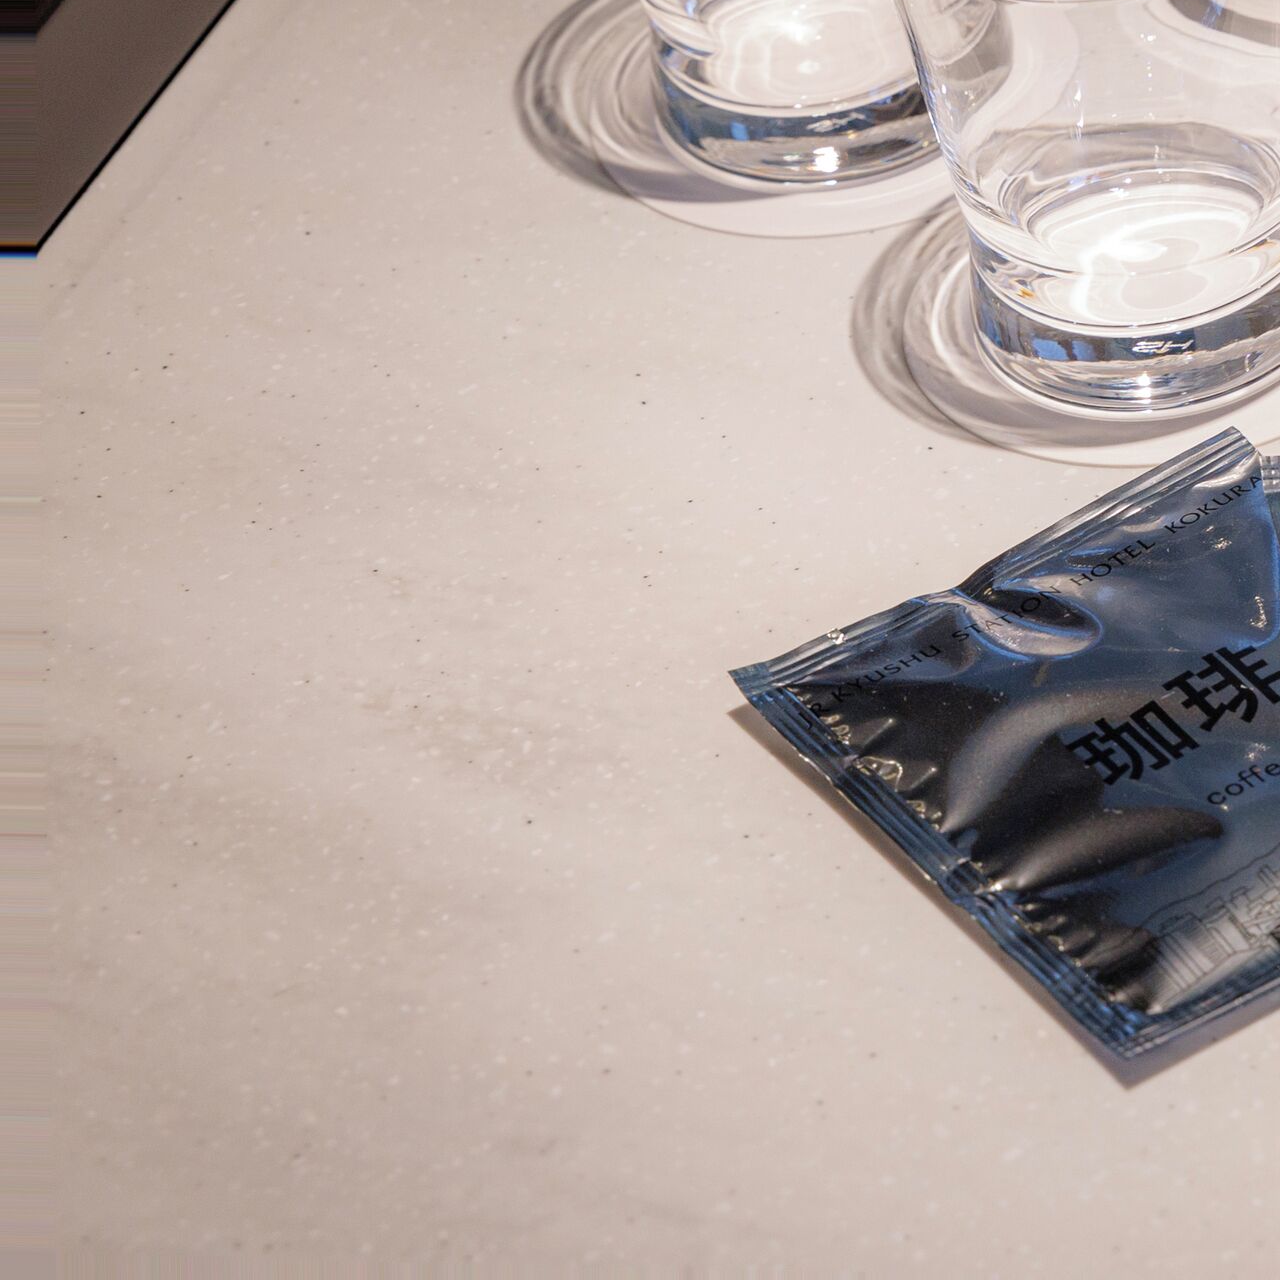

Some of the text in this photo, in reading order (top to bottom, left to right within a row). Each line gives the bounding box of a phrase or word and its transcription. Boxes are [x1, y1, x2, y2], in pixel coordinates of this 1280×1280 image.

[831, 644, 942, 702] KYUSHU
[952, 584, 1063, 642] STATION
[1071, 538, 1156, 586] HOTEL
[1163, 475, 1262, 535] KOKURA
